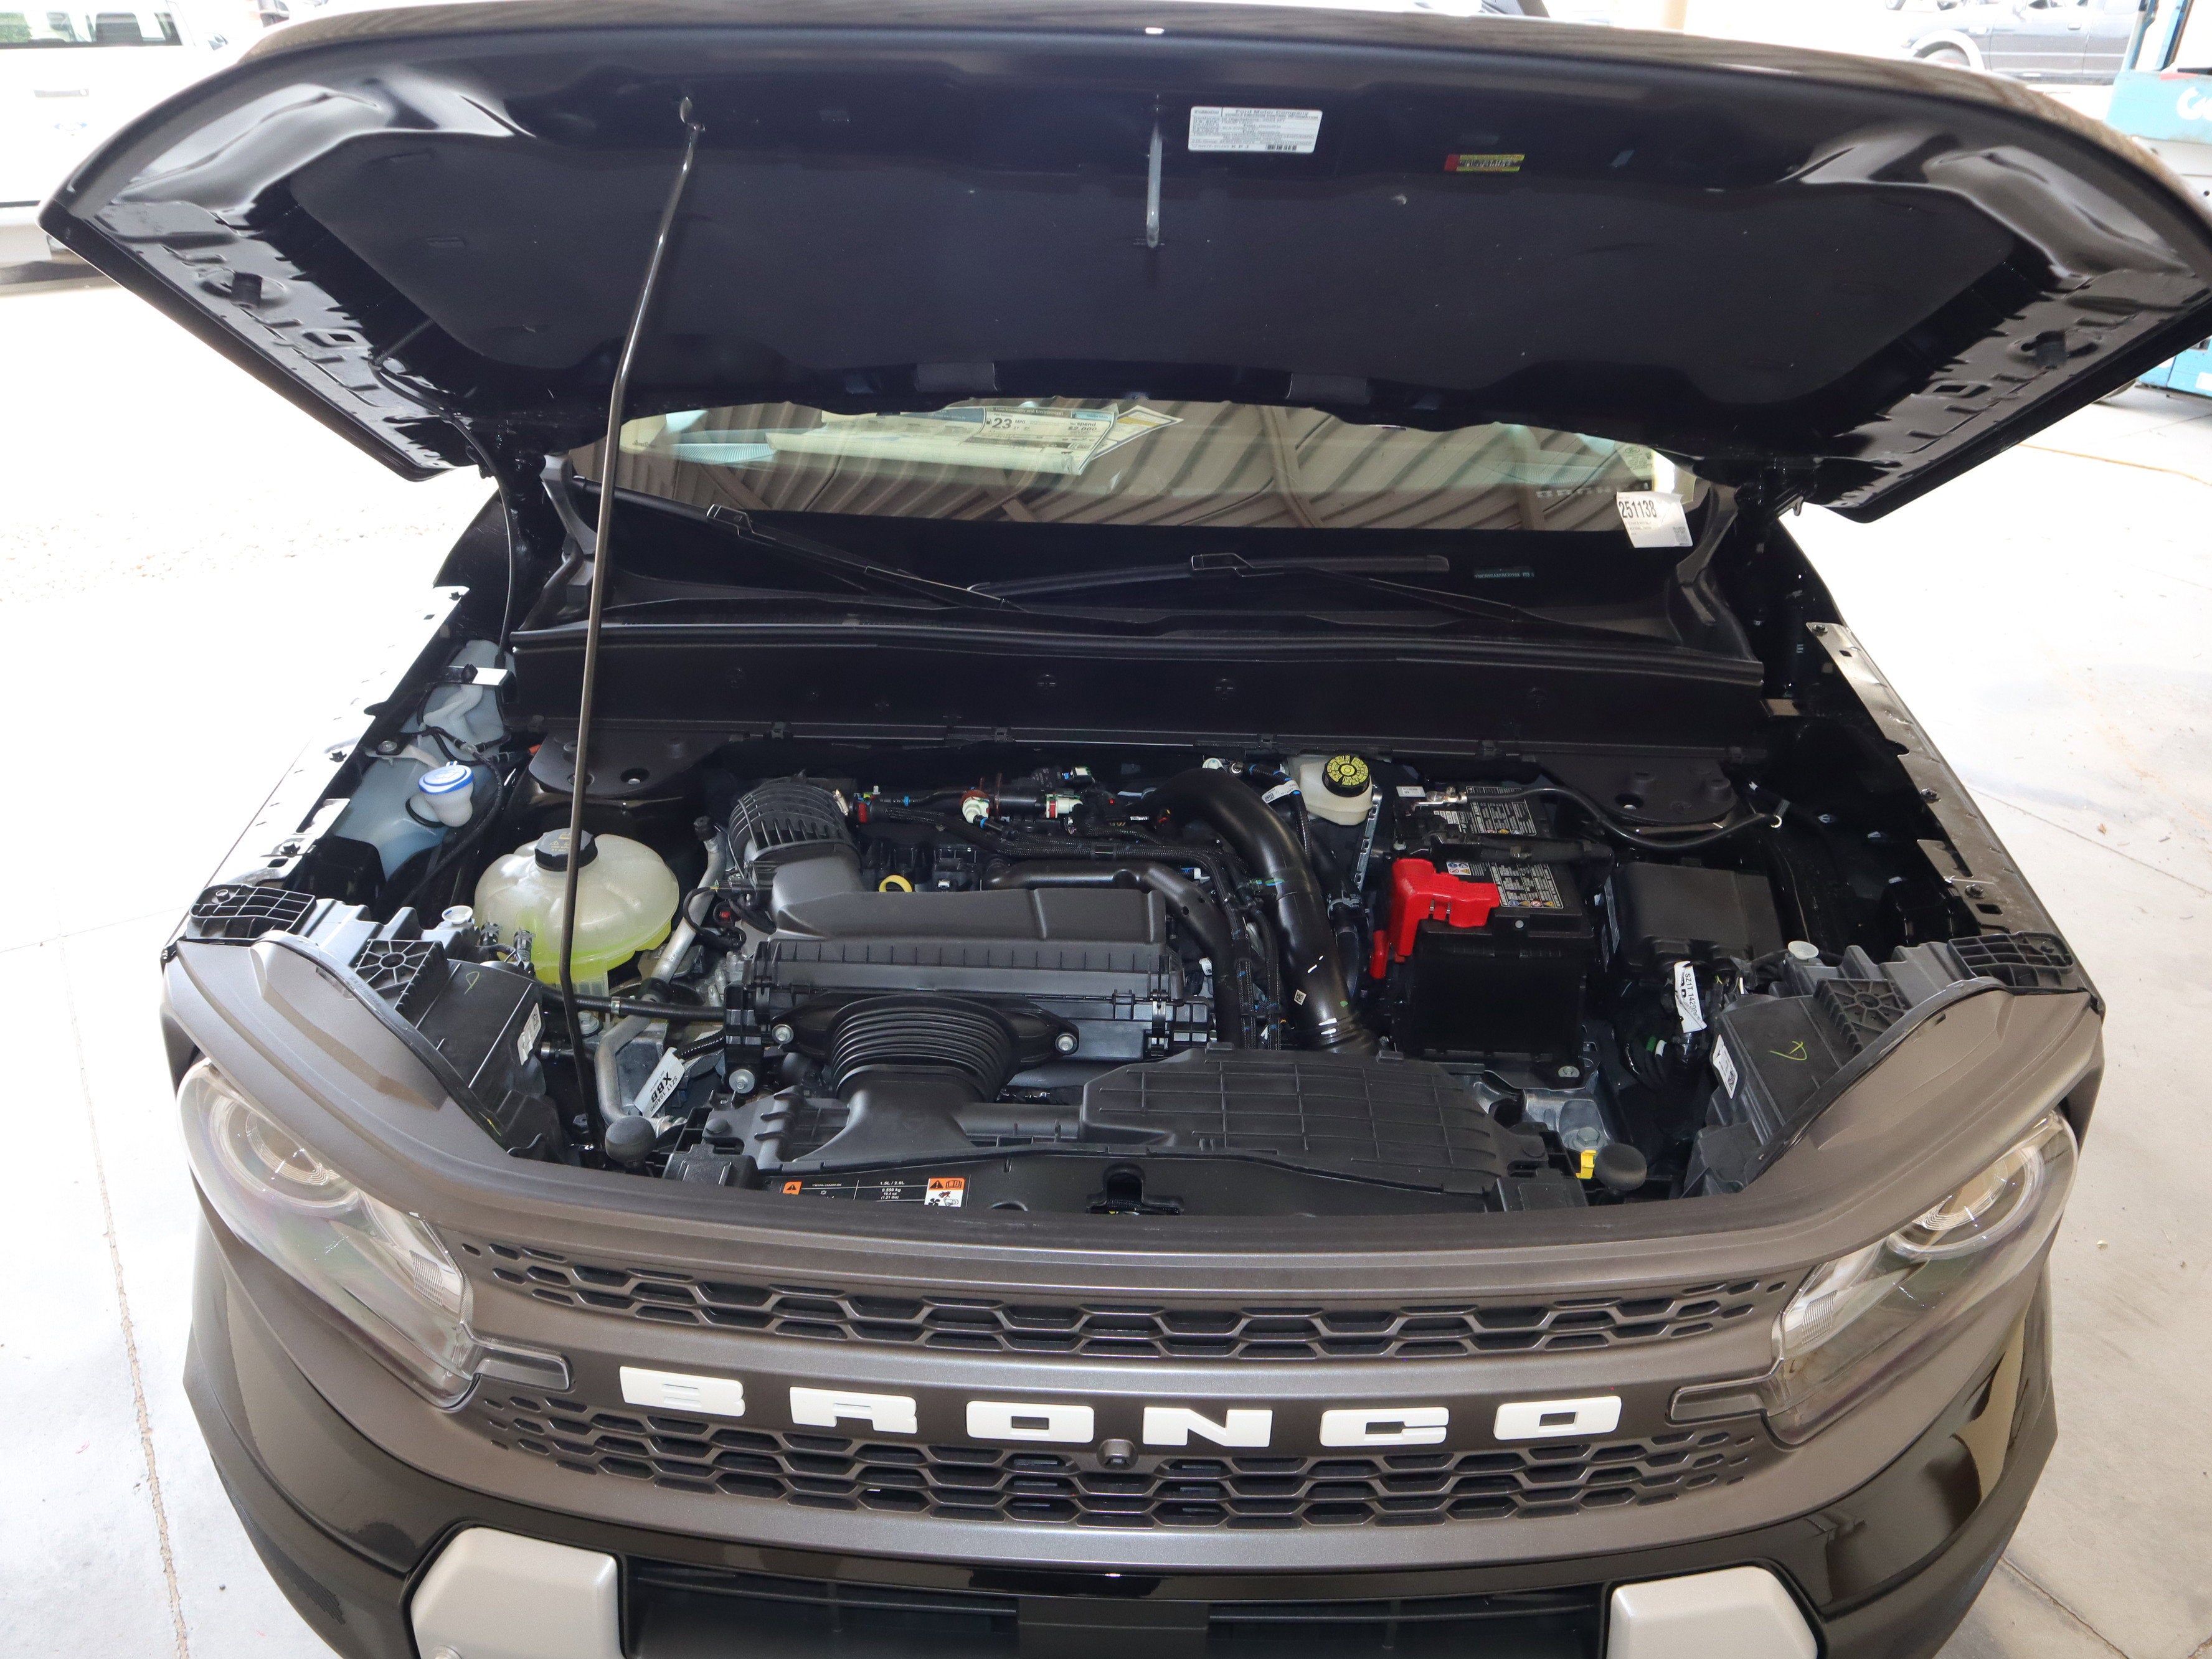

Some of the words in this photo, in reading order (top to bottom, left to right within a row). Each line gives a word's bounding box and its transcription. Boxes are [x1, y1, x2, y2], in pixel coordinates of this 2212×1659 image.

[991, 417, 1013, 428] 23
[1619, 500, 1657, 519] 251138
[1685, 973, 1693, 991] SZ1T
[651, 1071, 672, 1103] XBB
[620, 1366, 1622, 1447] BRONCO
